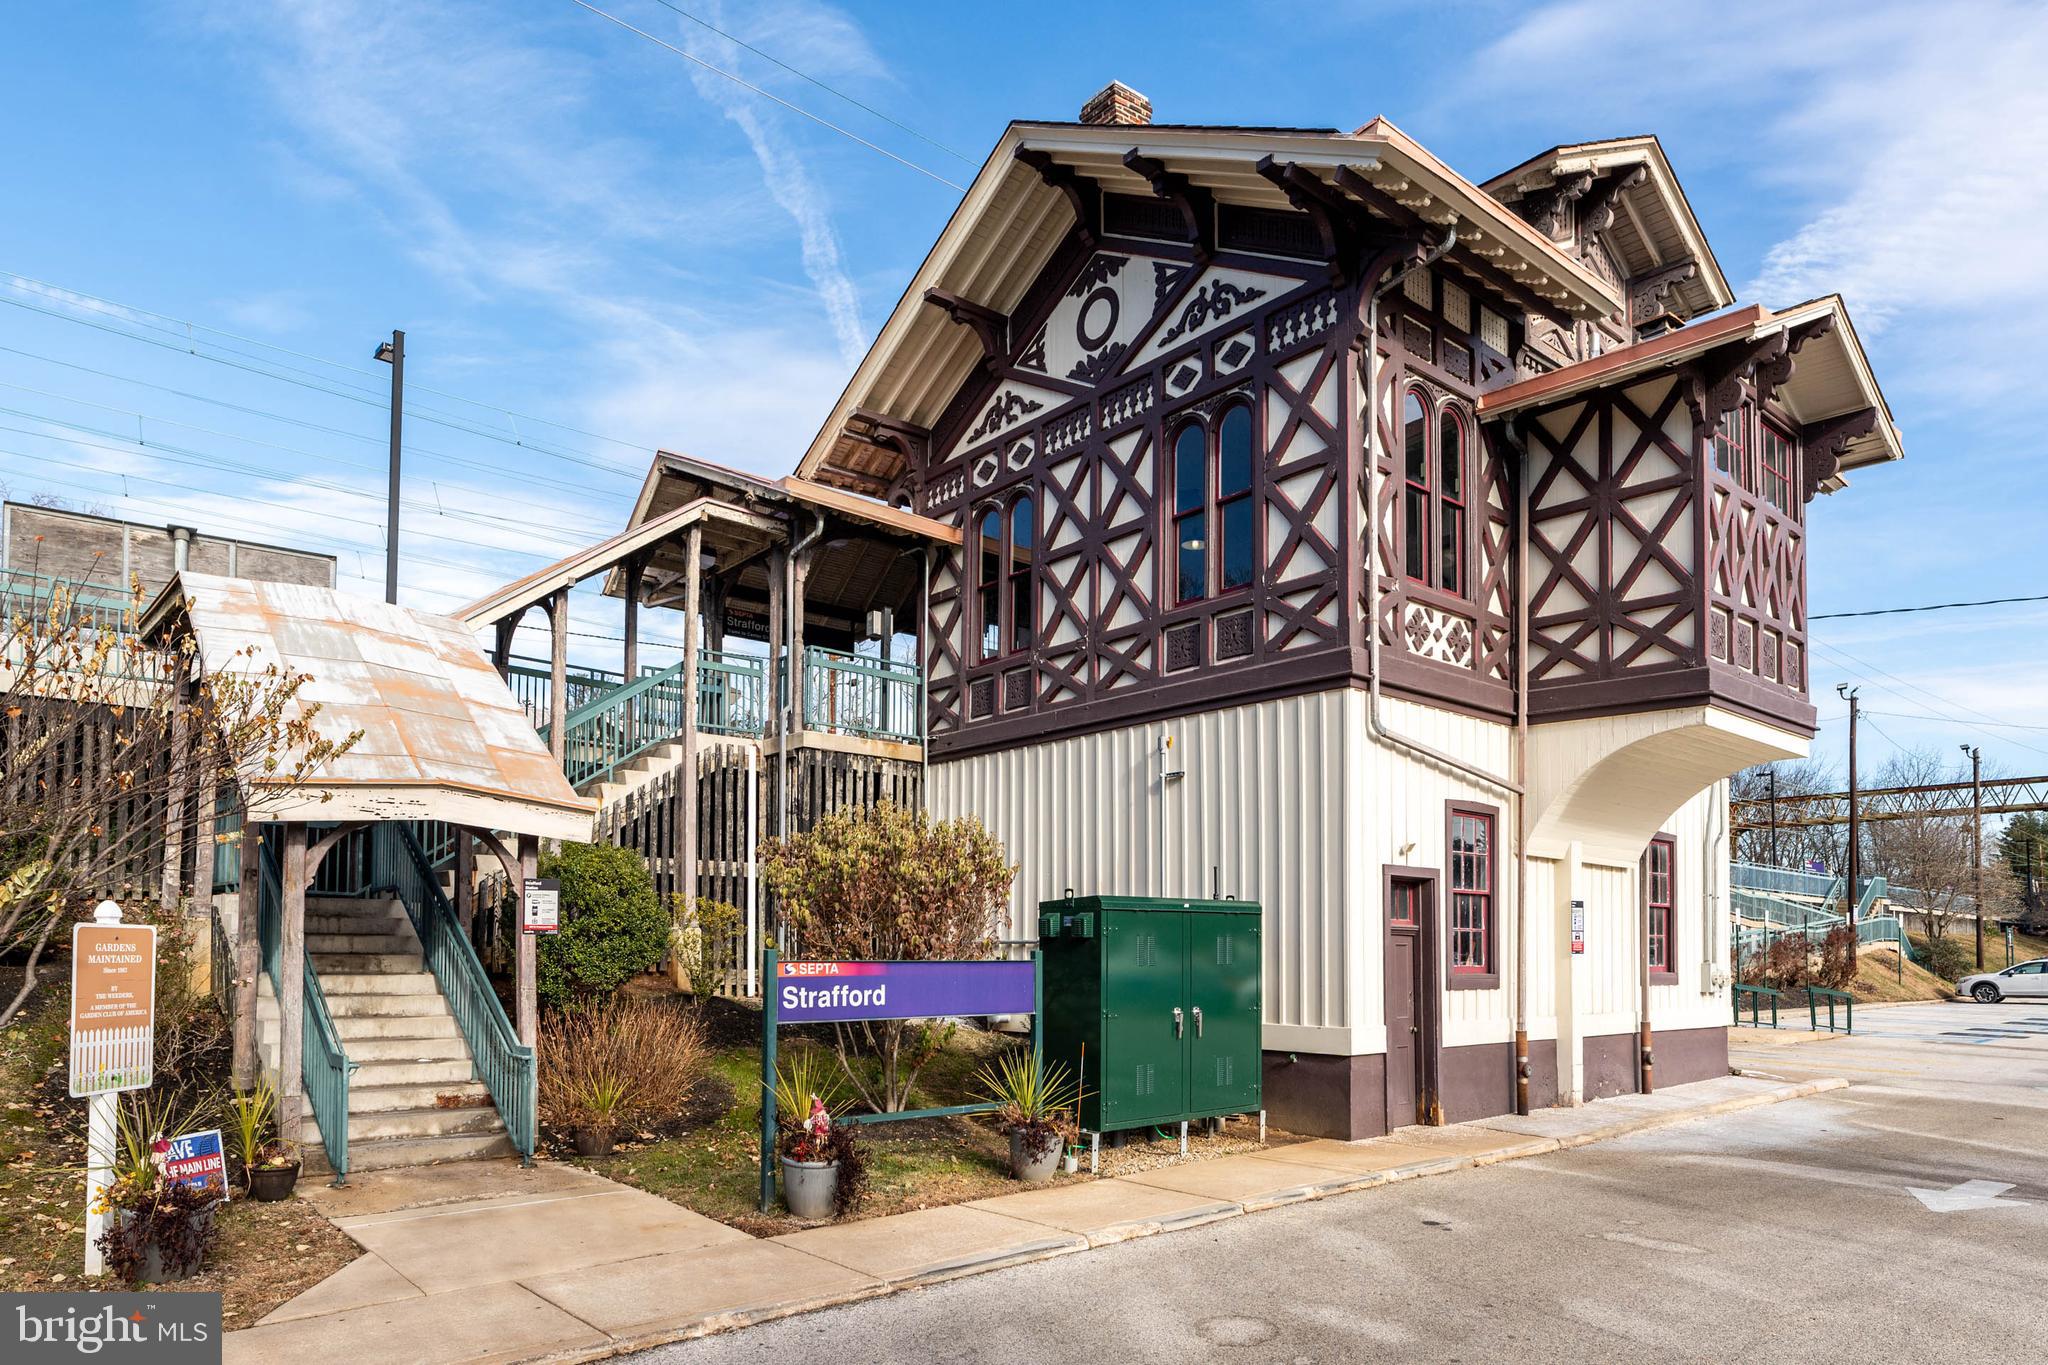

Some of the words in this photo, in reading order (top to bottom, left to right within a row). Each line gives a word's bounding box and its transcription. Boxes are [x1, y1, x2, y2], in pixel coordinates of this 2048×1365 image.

[95, 943, 137, 952] GARDENS
[88, 955, 142, 964] MAINTAINED
[799, 963, 839, 975] SEPTA
[782, 984, 886, 1009] Strafford
[168, 1139, 195, 1161] AVE
[179, 1161, 203, 1175] MAIN
[203, 1157, 221, 1171] LINE
